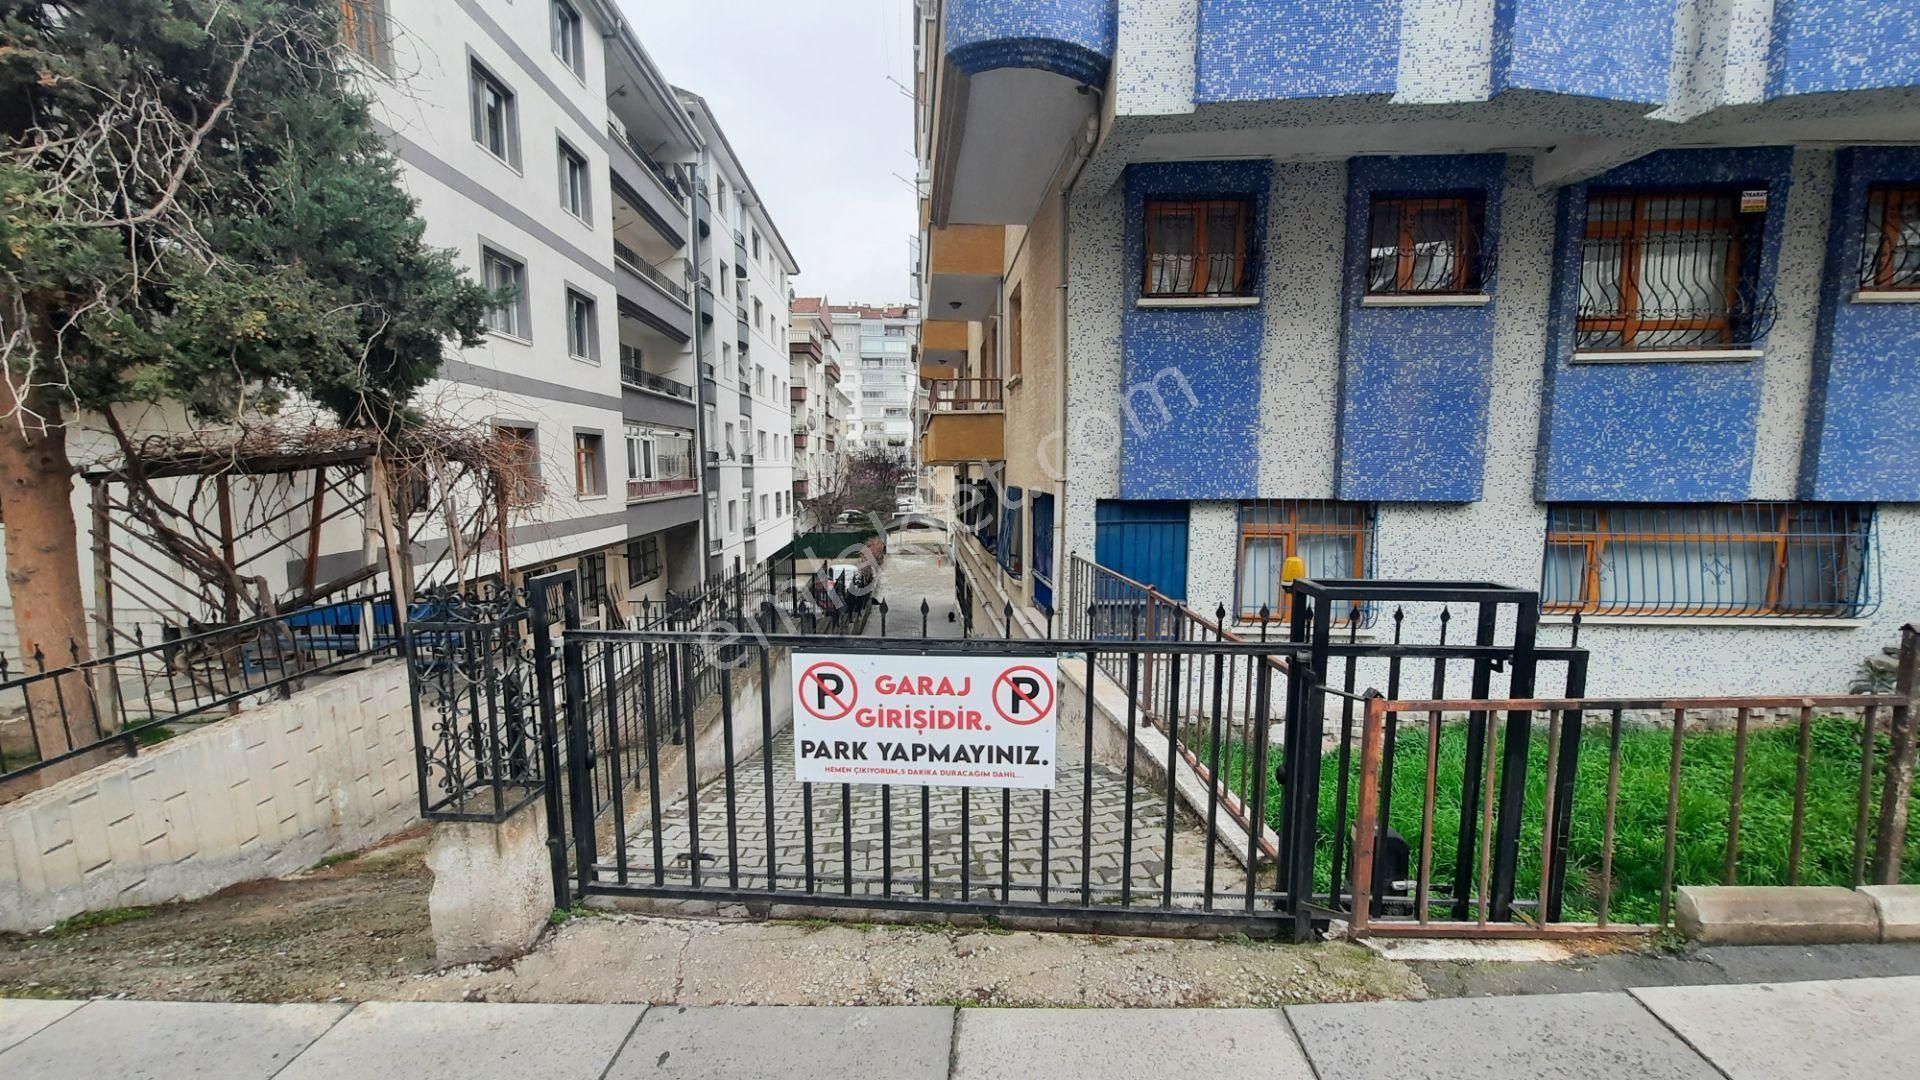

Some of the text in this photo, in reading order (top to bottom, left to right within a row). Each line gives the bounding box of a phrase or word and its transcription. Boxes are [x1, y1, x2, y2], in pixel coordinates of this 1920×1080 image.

[875, 675, 971, 696] GARAJ
[855, 704, 991, 735] GİRİŞİDİR.
[801, 740, 1049, 766] PARK YAPMAYINIZ.
